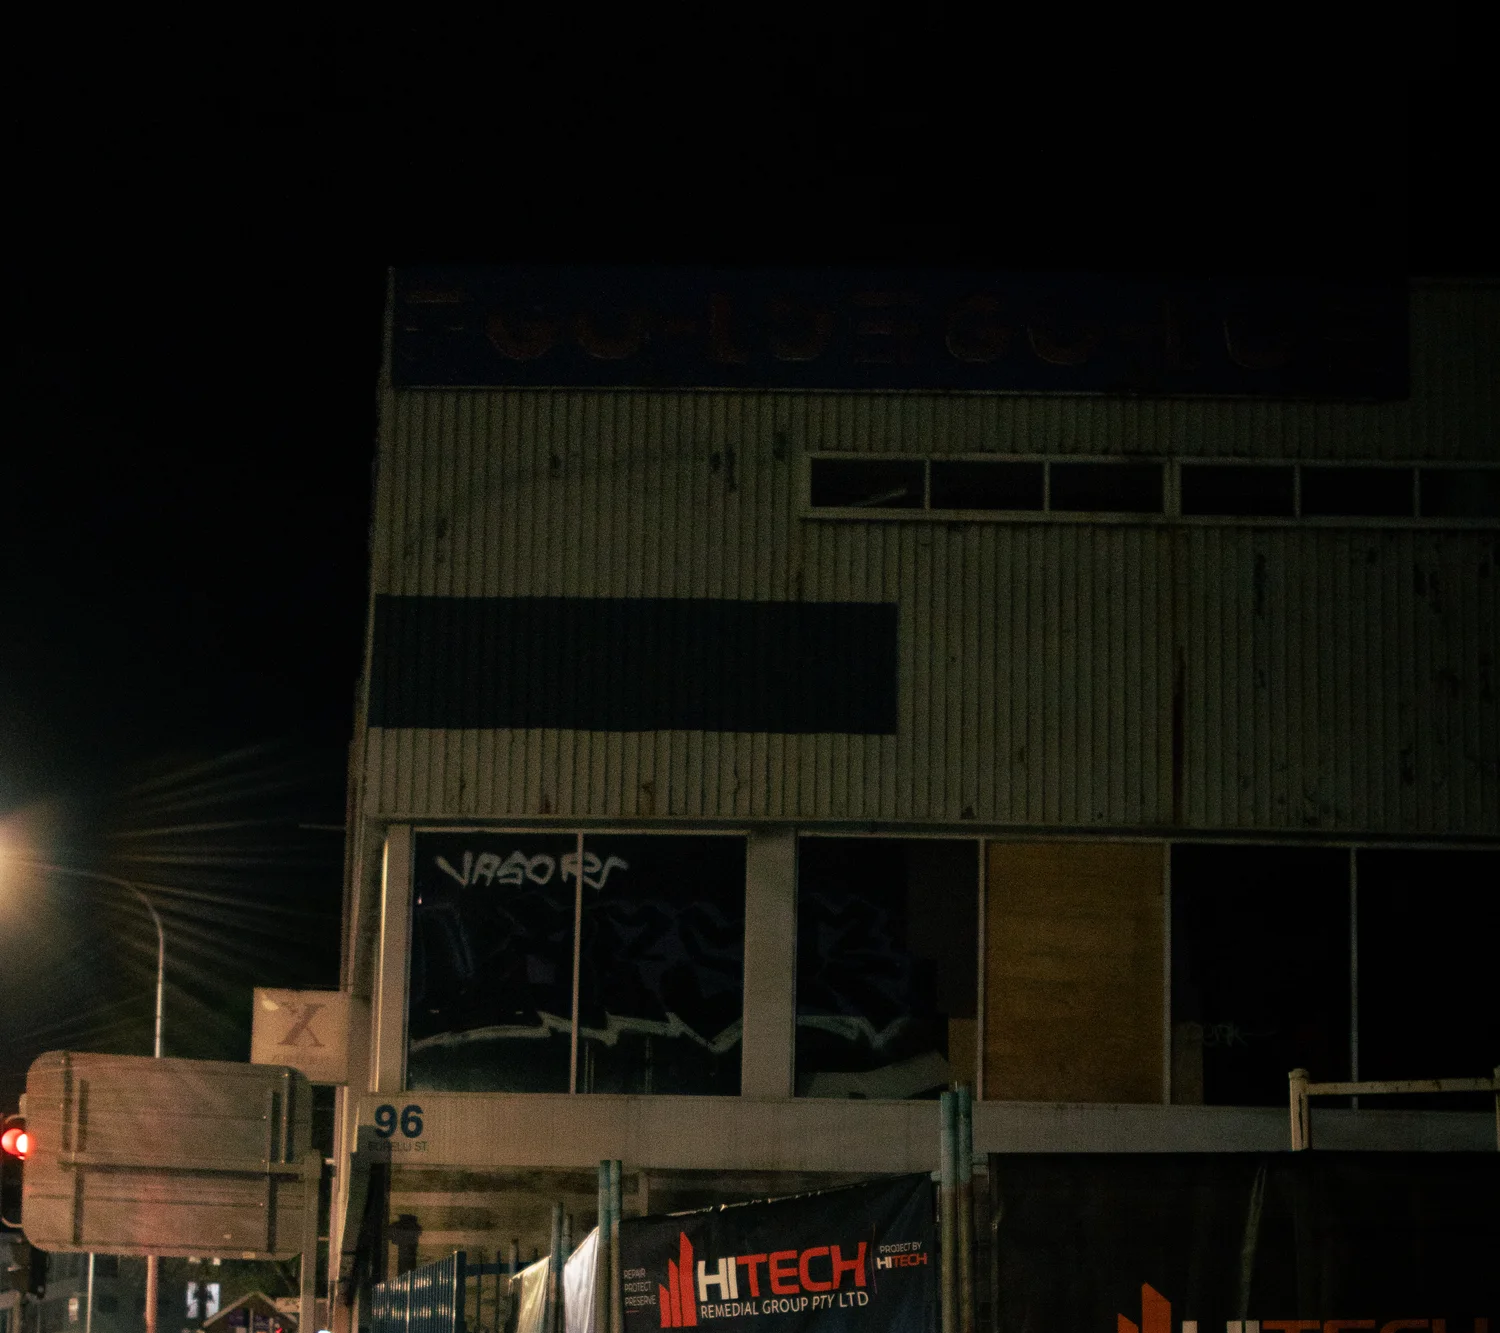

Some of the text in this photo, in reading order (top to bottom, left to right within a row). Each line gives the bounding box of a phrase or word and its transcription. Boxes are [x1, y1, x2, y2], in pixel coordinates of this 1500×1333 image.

[375, 1104, 424, 1138] 96
[415, 1141, 428, 1151] ST
[880, 1241, 922, 1253] PROJECT BY
[876, 1252, 928, 1269] HITECH
[697, 1241, 868, 1302] HITECH
[625, 1281, 651, 1292] PROTECT
[625, 1295, 657, 1306] PRESERVE
[701, 1291, 869, 1319] REMEDIAL GROUP PTY LTD
